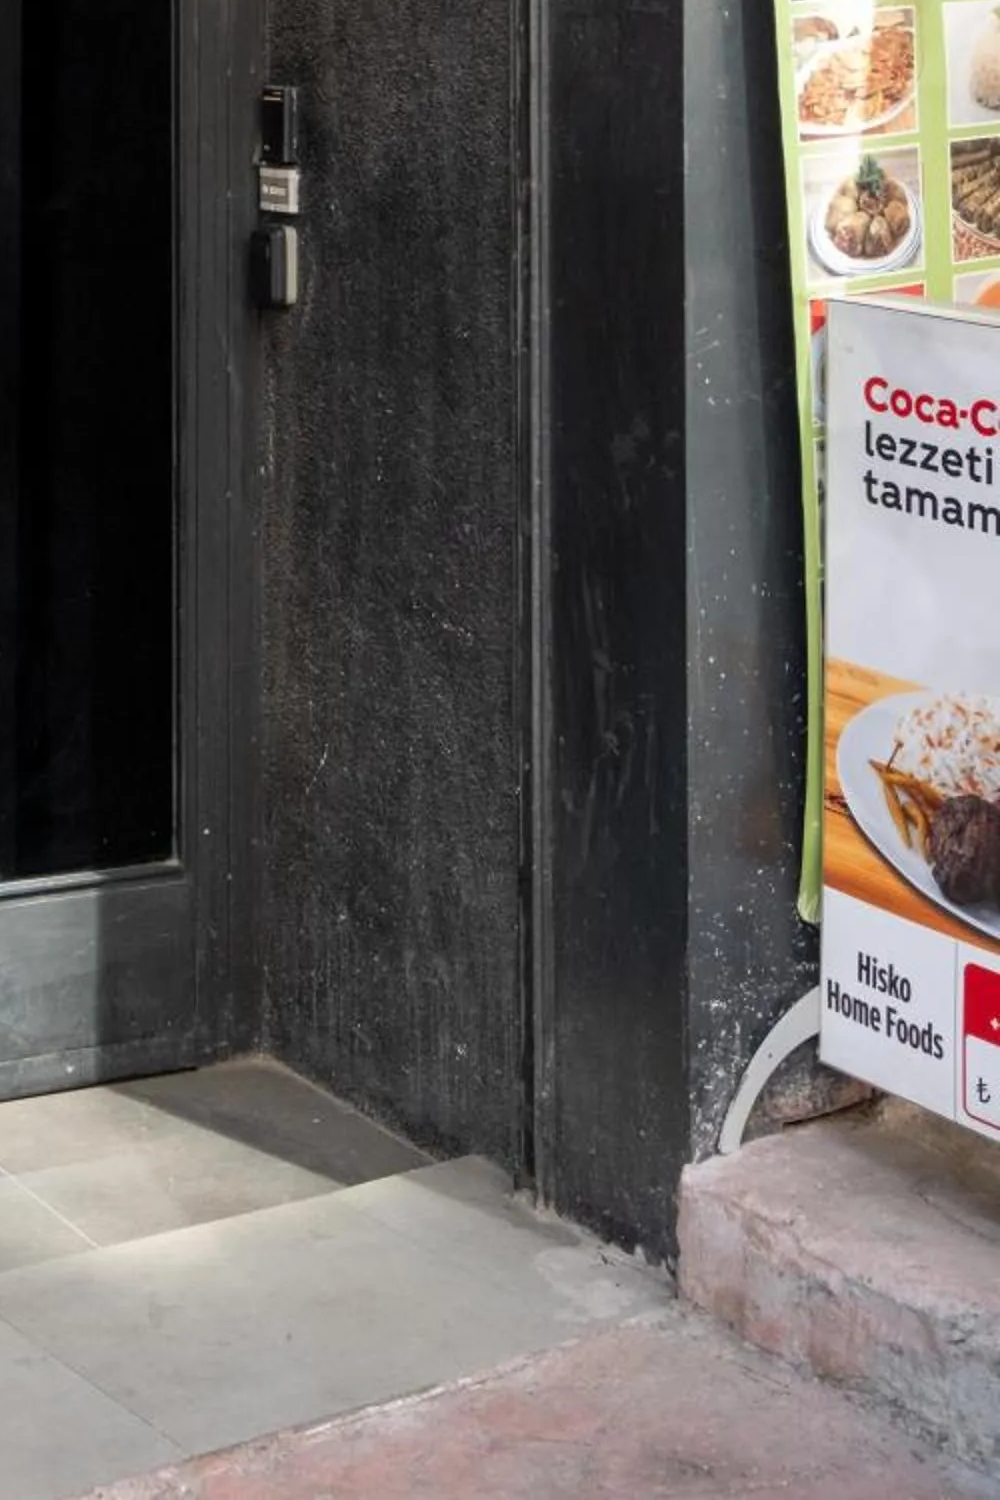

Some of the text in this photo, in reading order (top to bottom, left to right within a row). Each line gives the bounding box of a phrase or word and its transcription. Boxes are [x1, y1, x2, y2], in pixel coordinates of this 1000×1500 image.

[864, 376, 1000, 436] Coca-C
[865, 420, 993, 485] lezzeti
[863, 470, 1000, 536] tamam
[857, 951, 911, 1003] Hisko
[827, 979, 944, 1060] Home Foods
